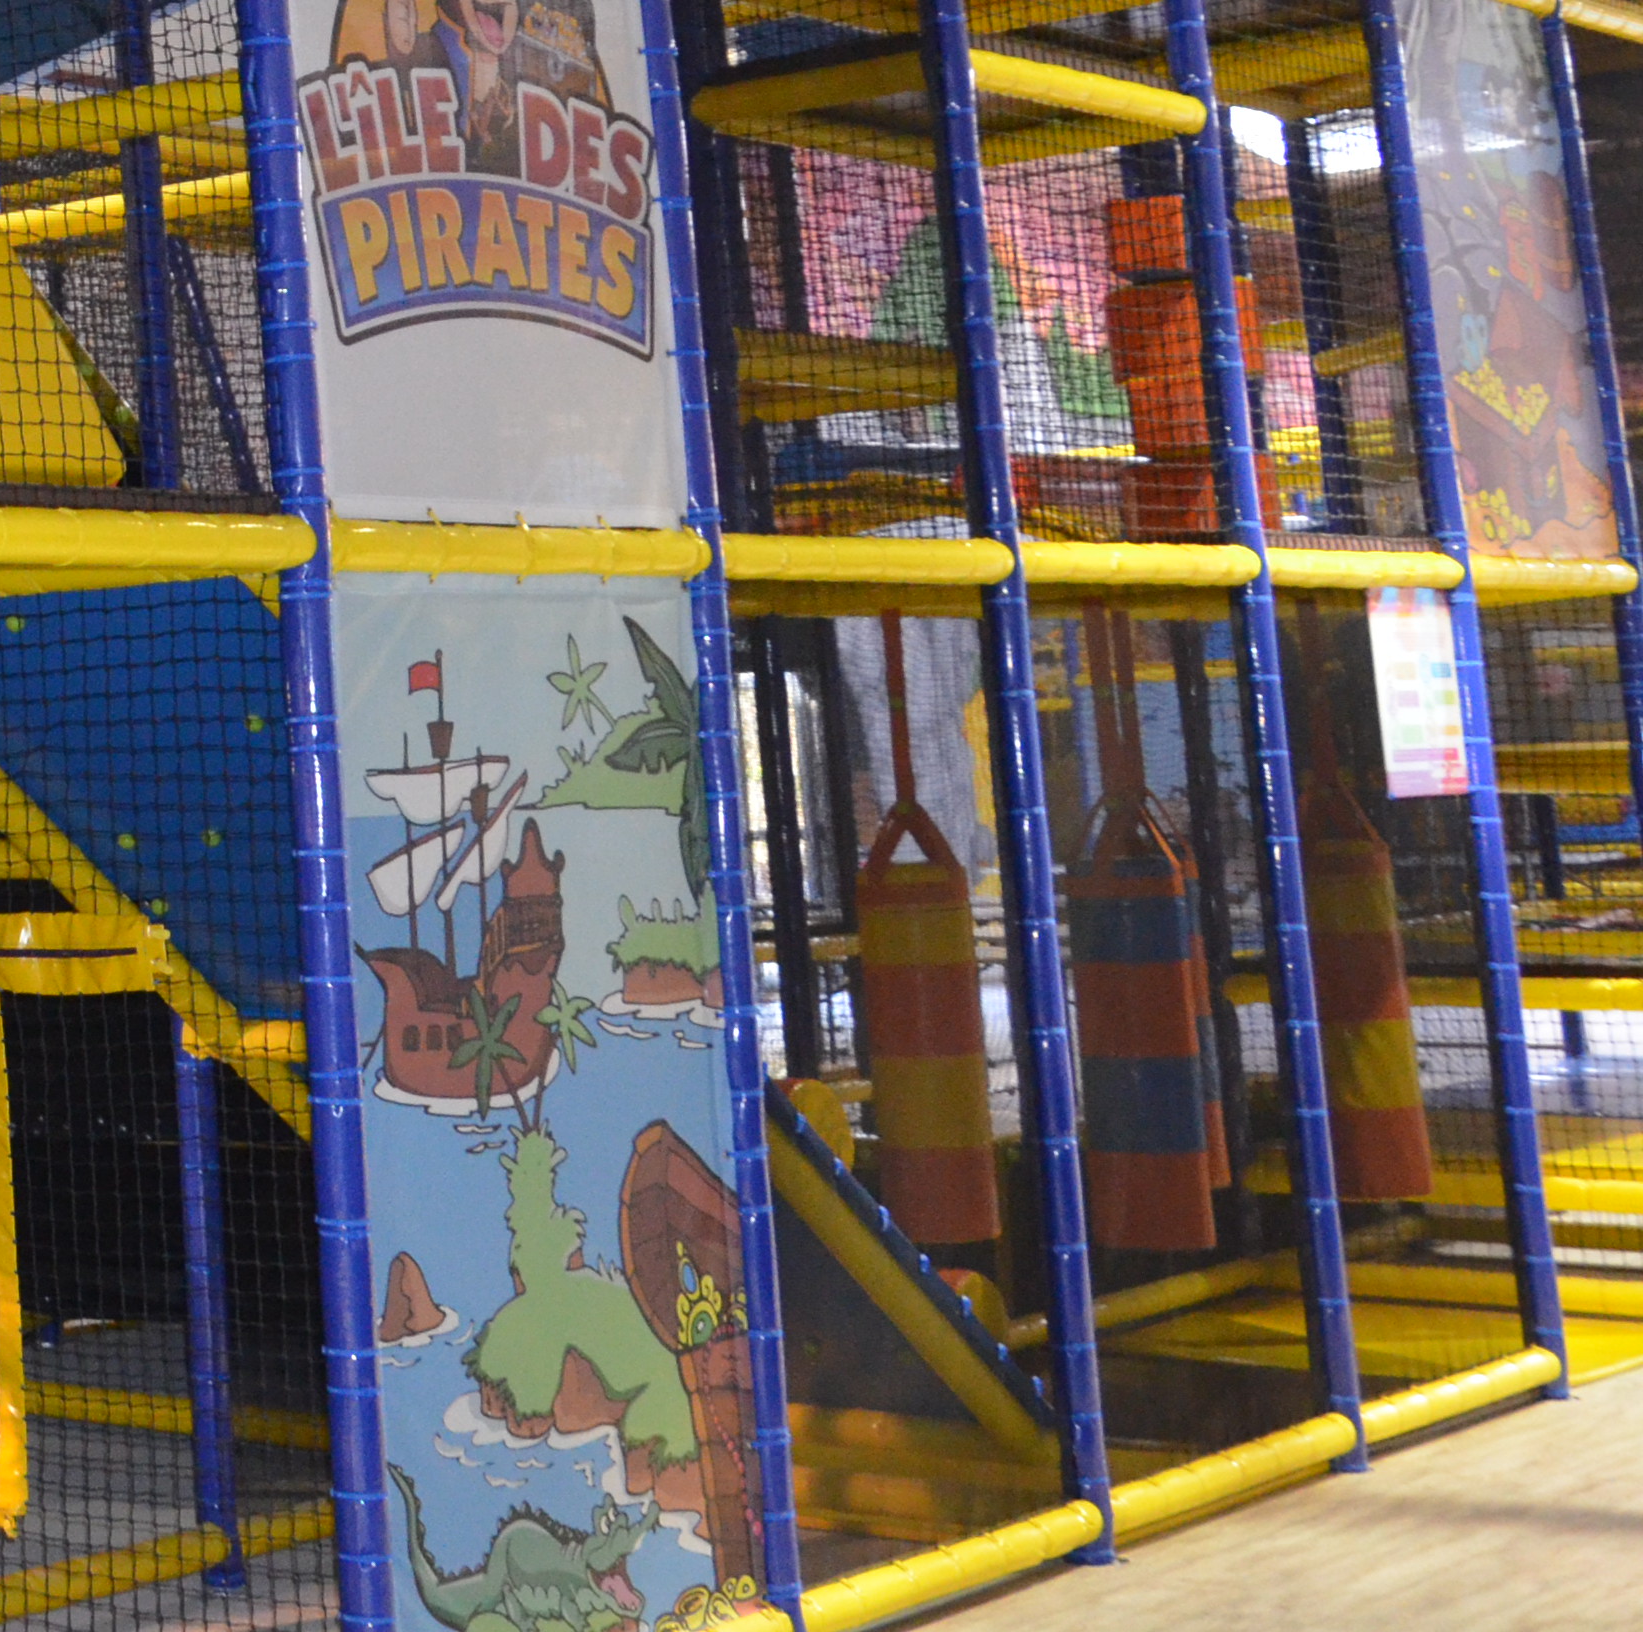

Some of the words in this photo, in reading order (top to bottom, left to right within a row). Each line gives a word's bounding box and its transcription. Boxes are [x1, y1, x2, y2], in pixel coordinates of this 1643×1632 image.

[304, 69, 463, 193] L'ÎLE
[521, 90, 643, 221] DES
[339, 187, 637, 319] PIRATES
